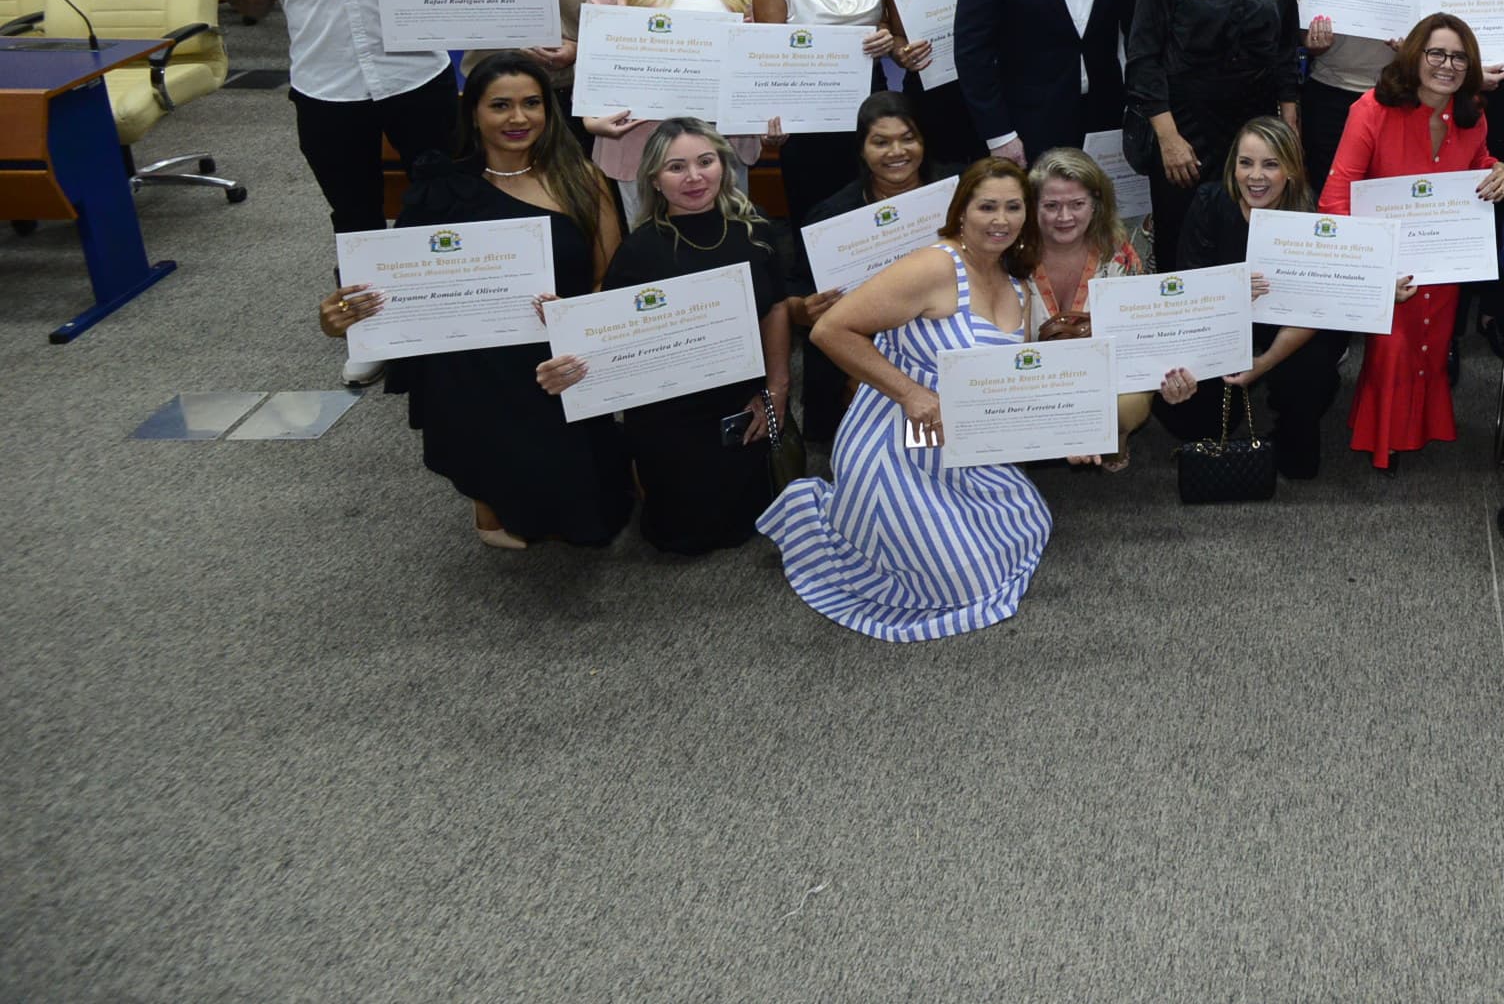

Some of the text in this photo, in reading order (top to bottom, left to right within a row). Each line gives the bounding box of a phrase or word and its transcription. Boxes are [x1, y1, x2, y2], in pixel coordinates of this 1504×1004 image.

[375, 259, 419, 270] Diploma
[420, 258, 431, 267] de
[435, 255, 466, 265] Honra
[1306, 270, 1332, 278] Oliveira
[390, 292, 429, 303] Rayanne
[475, 285, 509, 295] Oliveira
[584, 320, 628, 336] Diploma
[628, 317, 639, 326] de
[643, 310, 673, 323] Honra
[1156, 329, 1176, 337] Maria
[1176, 324, 1211, 335] Fernandes
[636, 342, 671, 356] Ferreira
[683, 334, 706, 345] Jesus
[983, 407, 1006, 415] Maria
[1025, 403, 1056, 412] Ferreira
[1056, 401, 1075, 409] Leite
